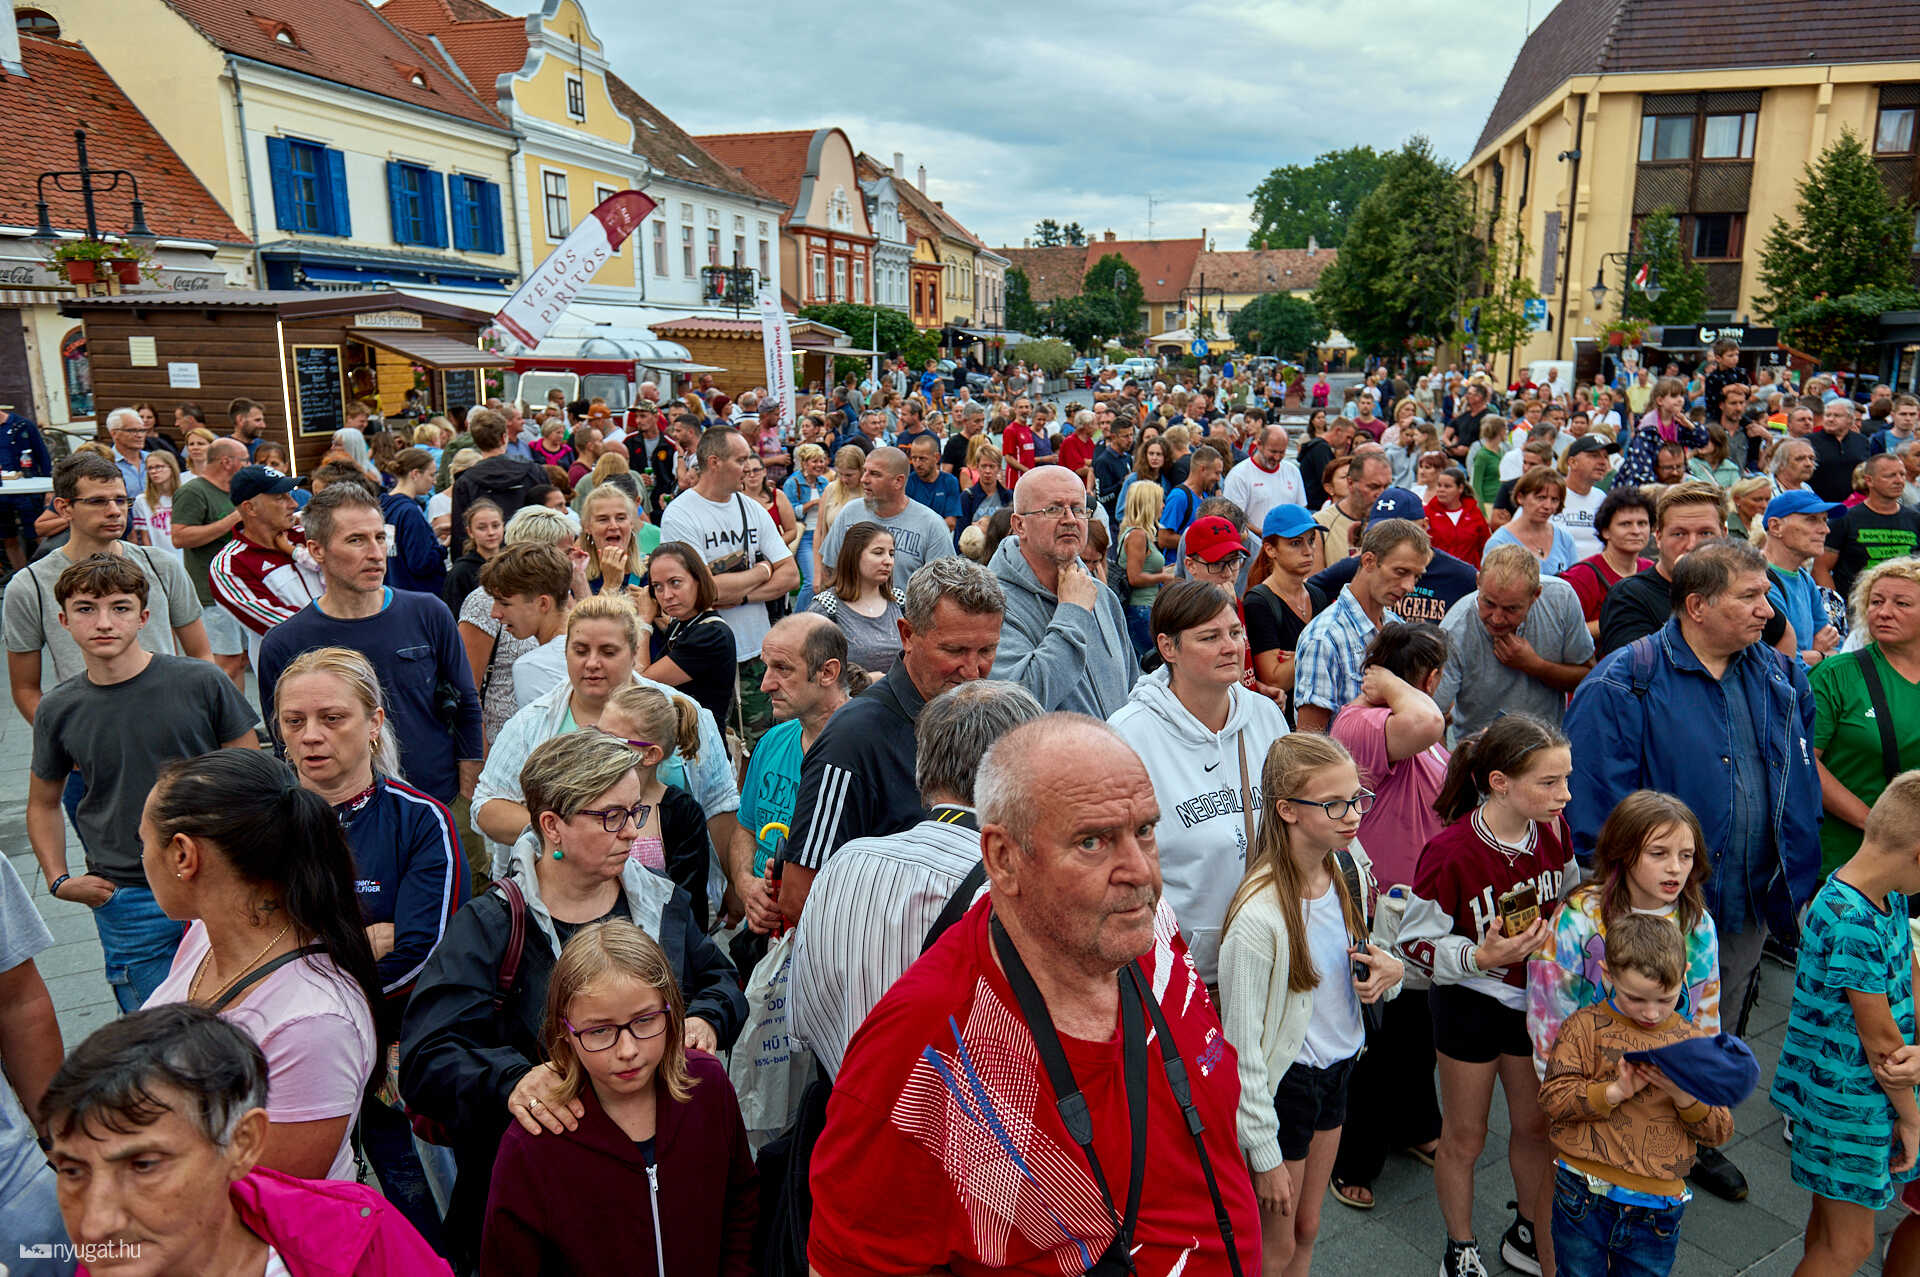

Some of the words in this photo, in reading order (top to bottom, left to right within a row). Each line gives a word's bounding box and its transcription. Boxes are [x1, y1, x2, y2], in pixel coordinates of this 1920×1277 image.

[523, 249, 578, 309] VELŐS
[540, 247, 606, 324] PIRÍTÓS
[1387, 596, 1446, 620] NGELES
